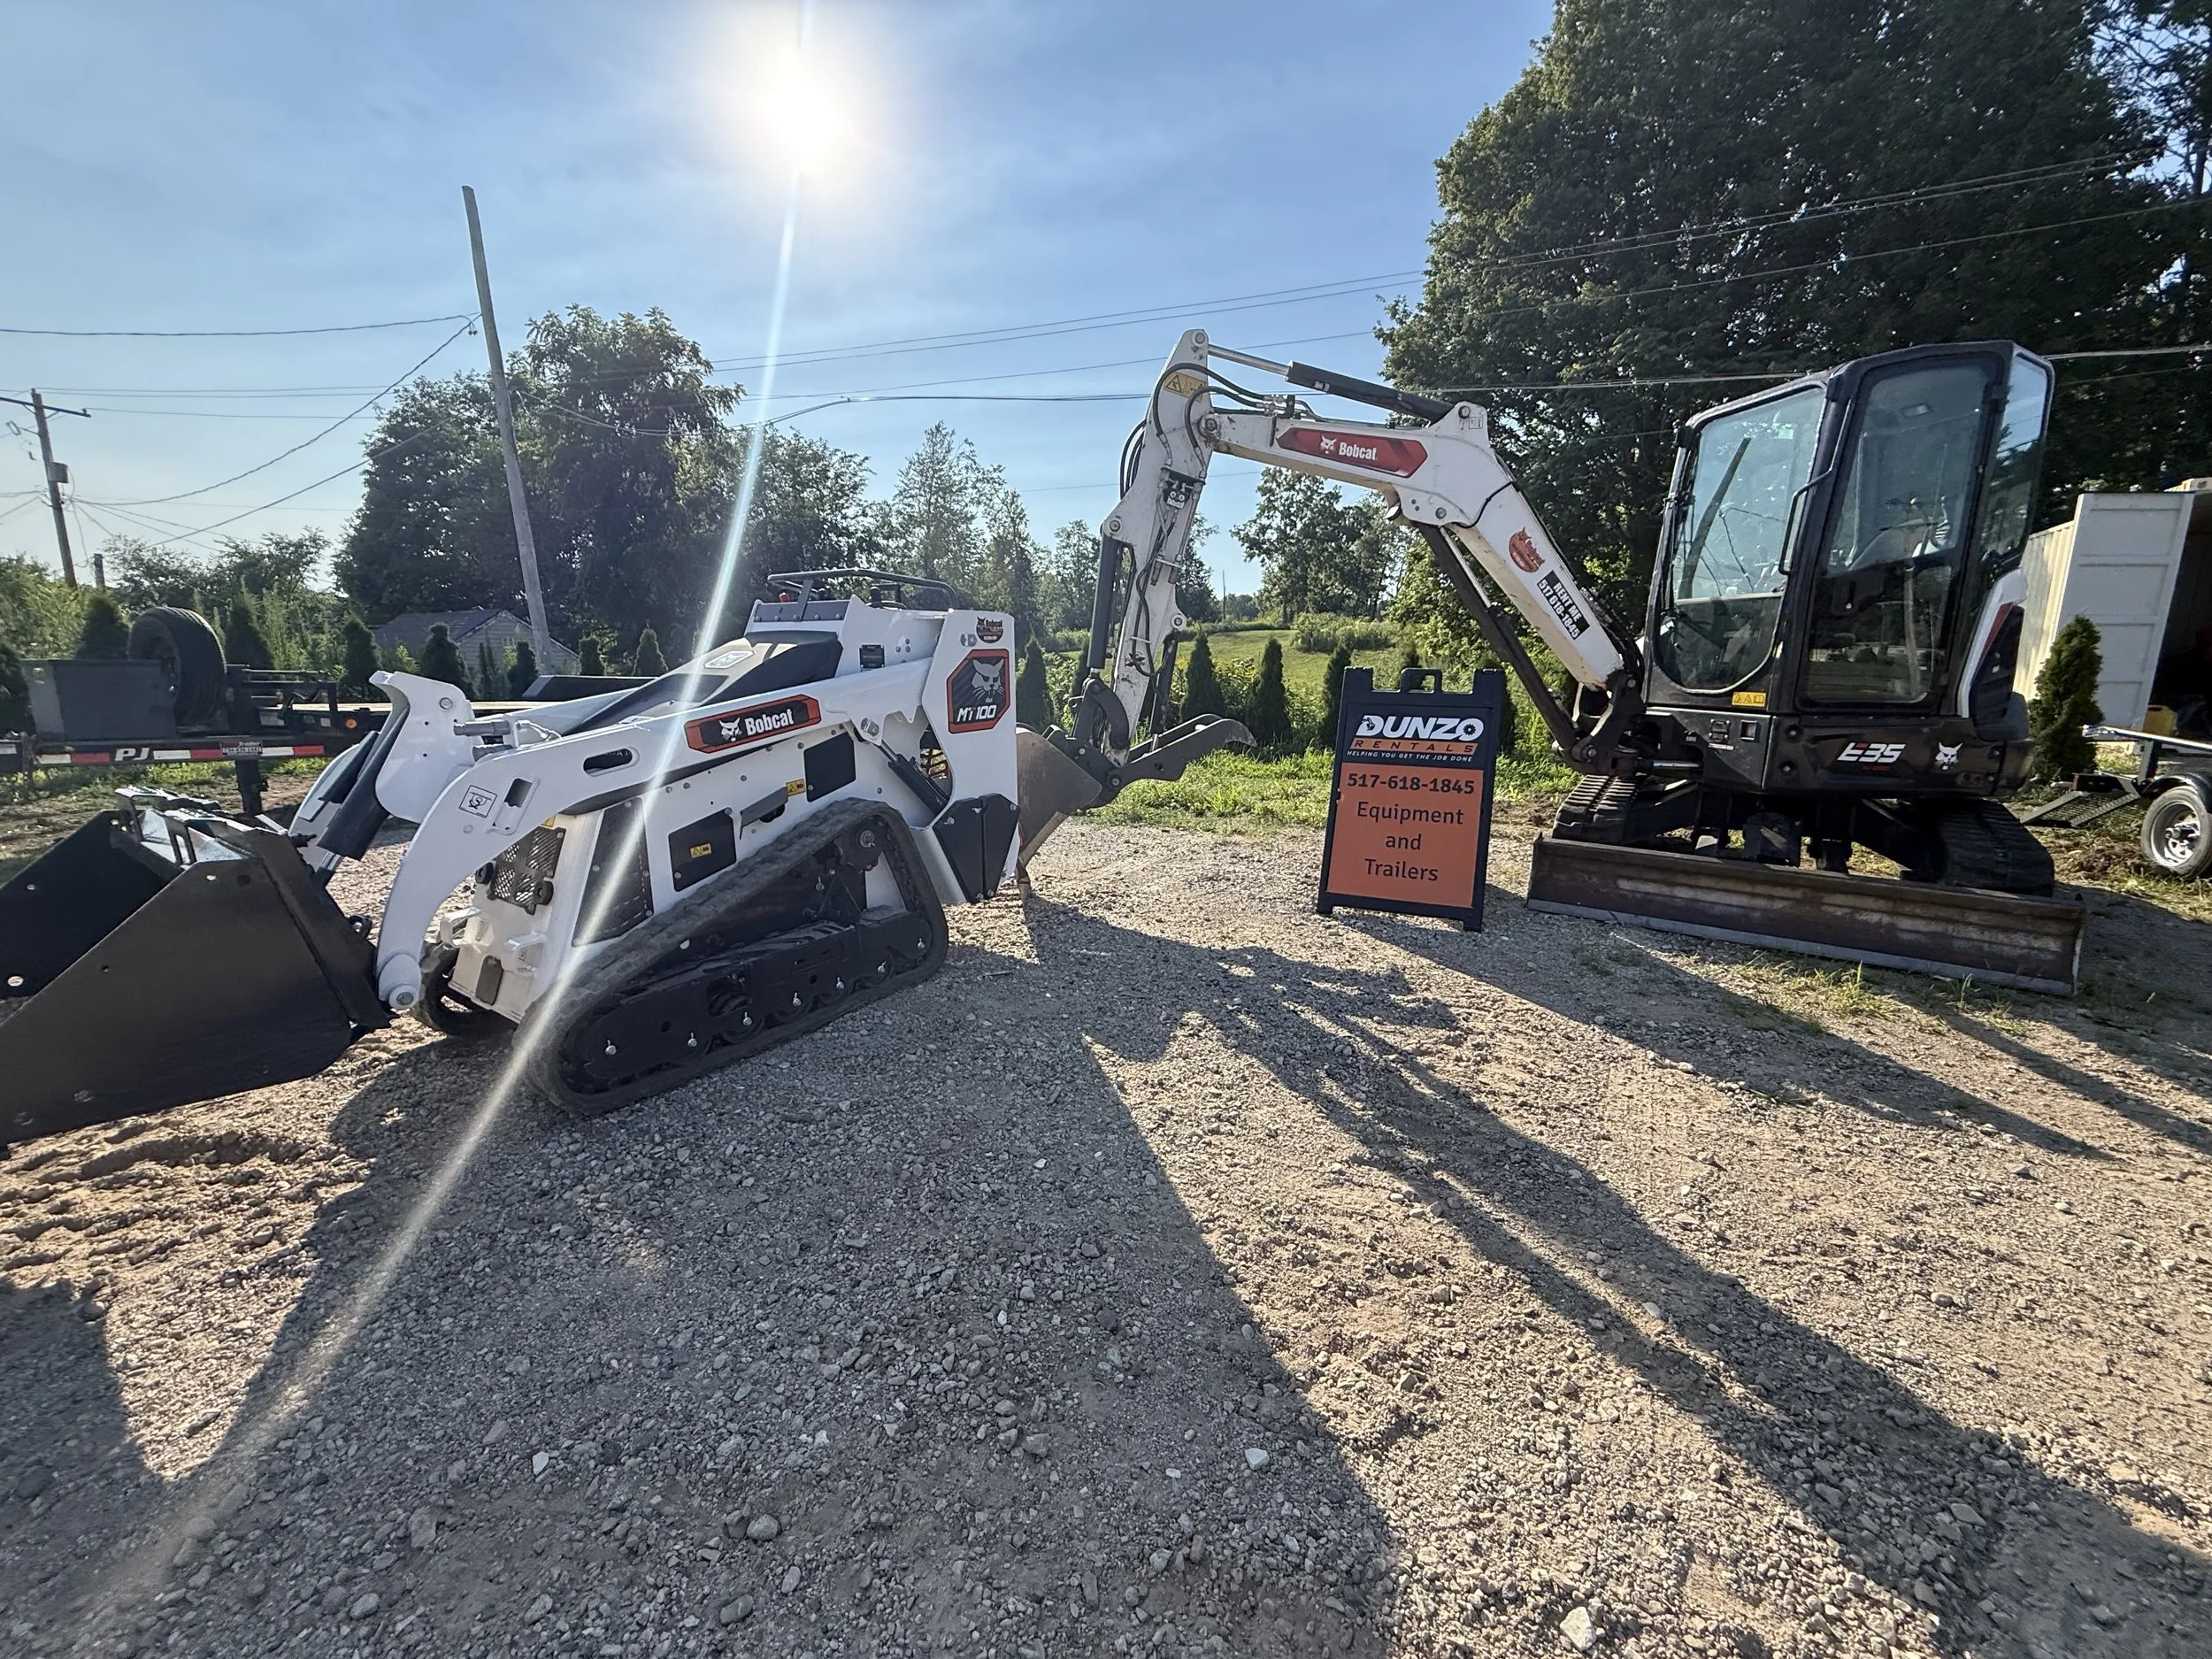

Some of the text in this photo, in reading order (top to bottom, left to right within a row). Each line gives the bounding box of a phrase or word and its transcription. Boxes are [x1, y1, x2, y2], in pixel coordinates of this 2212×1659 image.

[1339, 442, 1377, 461] Bobcat
[1539, 579, 1580, 638] 517 618-1845
[1553, 582, 1582, 622] RENT ME
[744, 708, 795, 736] Bobcat
[1356, 714, 1485, 741] DUNZO
[114, 747, 150, 762] PJ
[1354, 740, 1475, 753] RENTALS
[1837, 741, 1906, 764] E35
[1347, 772, 1475, 795] 517-618-1845
[1356, 801, 1464, 825] Equipment
[1385, 833, 1422, 850] and
[1364, 857, 1439, 881] Trailers
